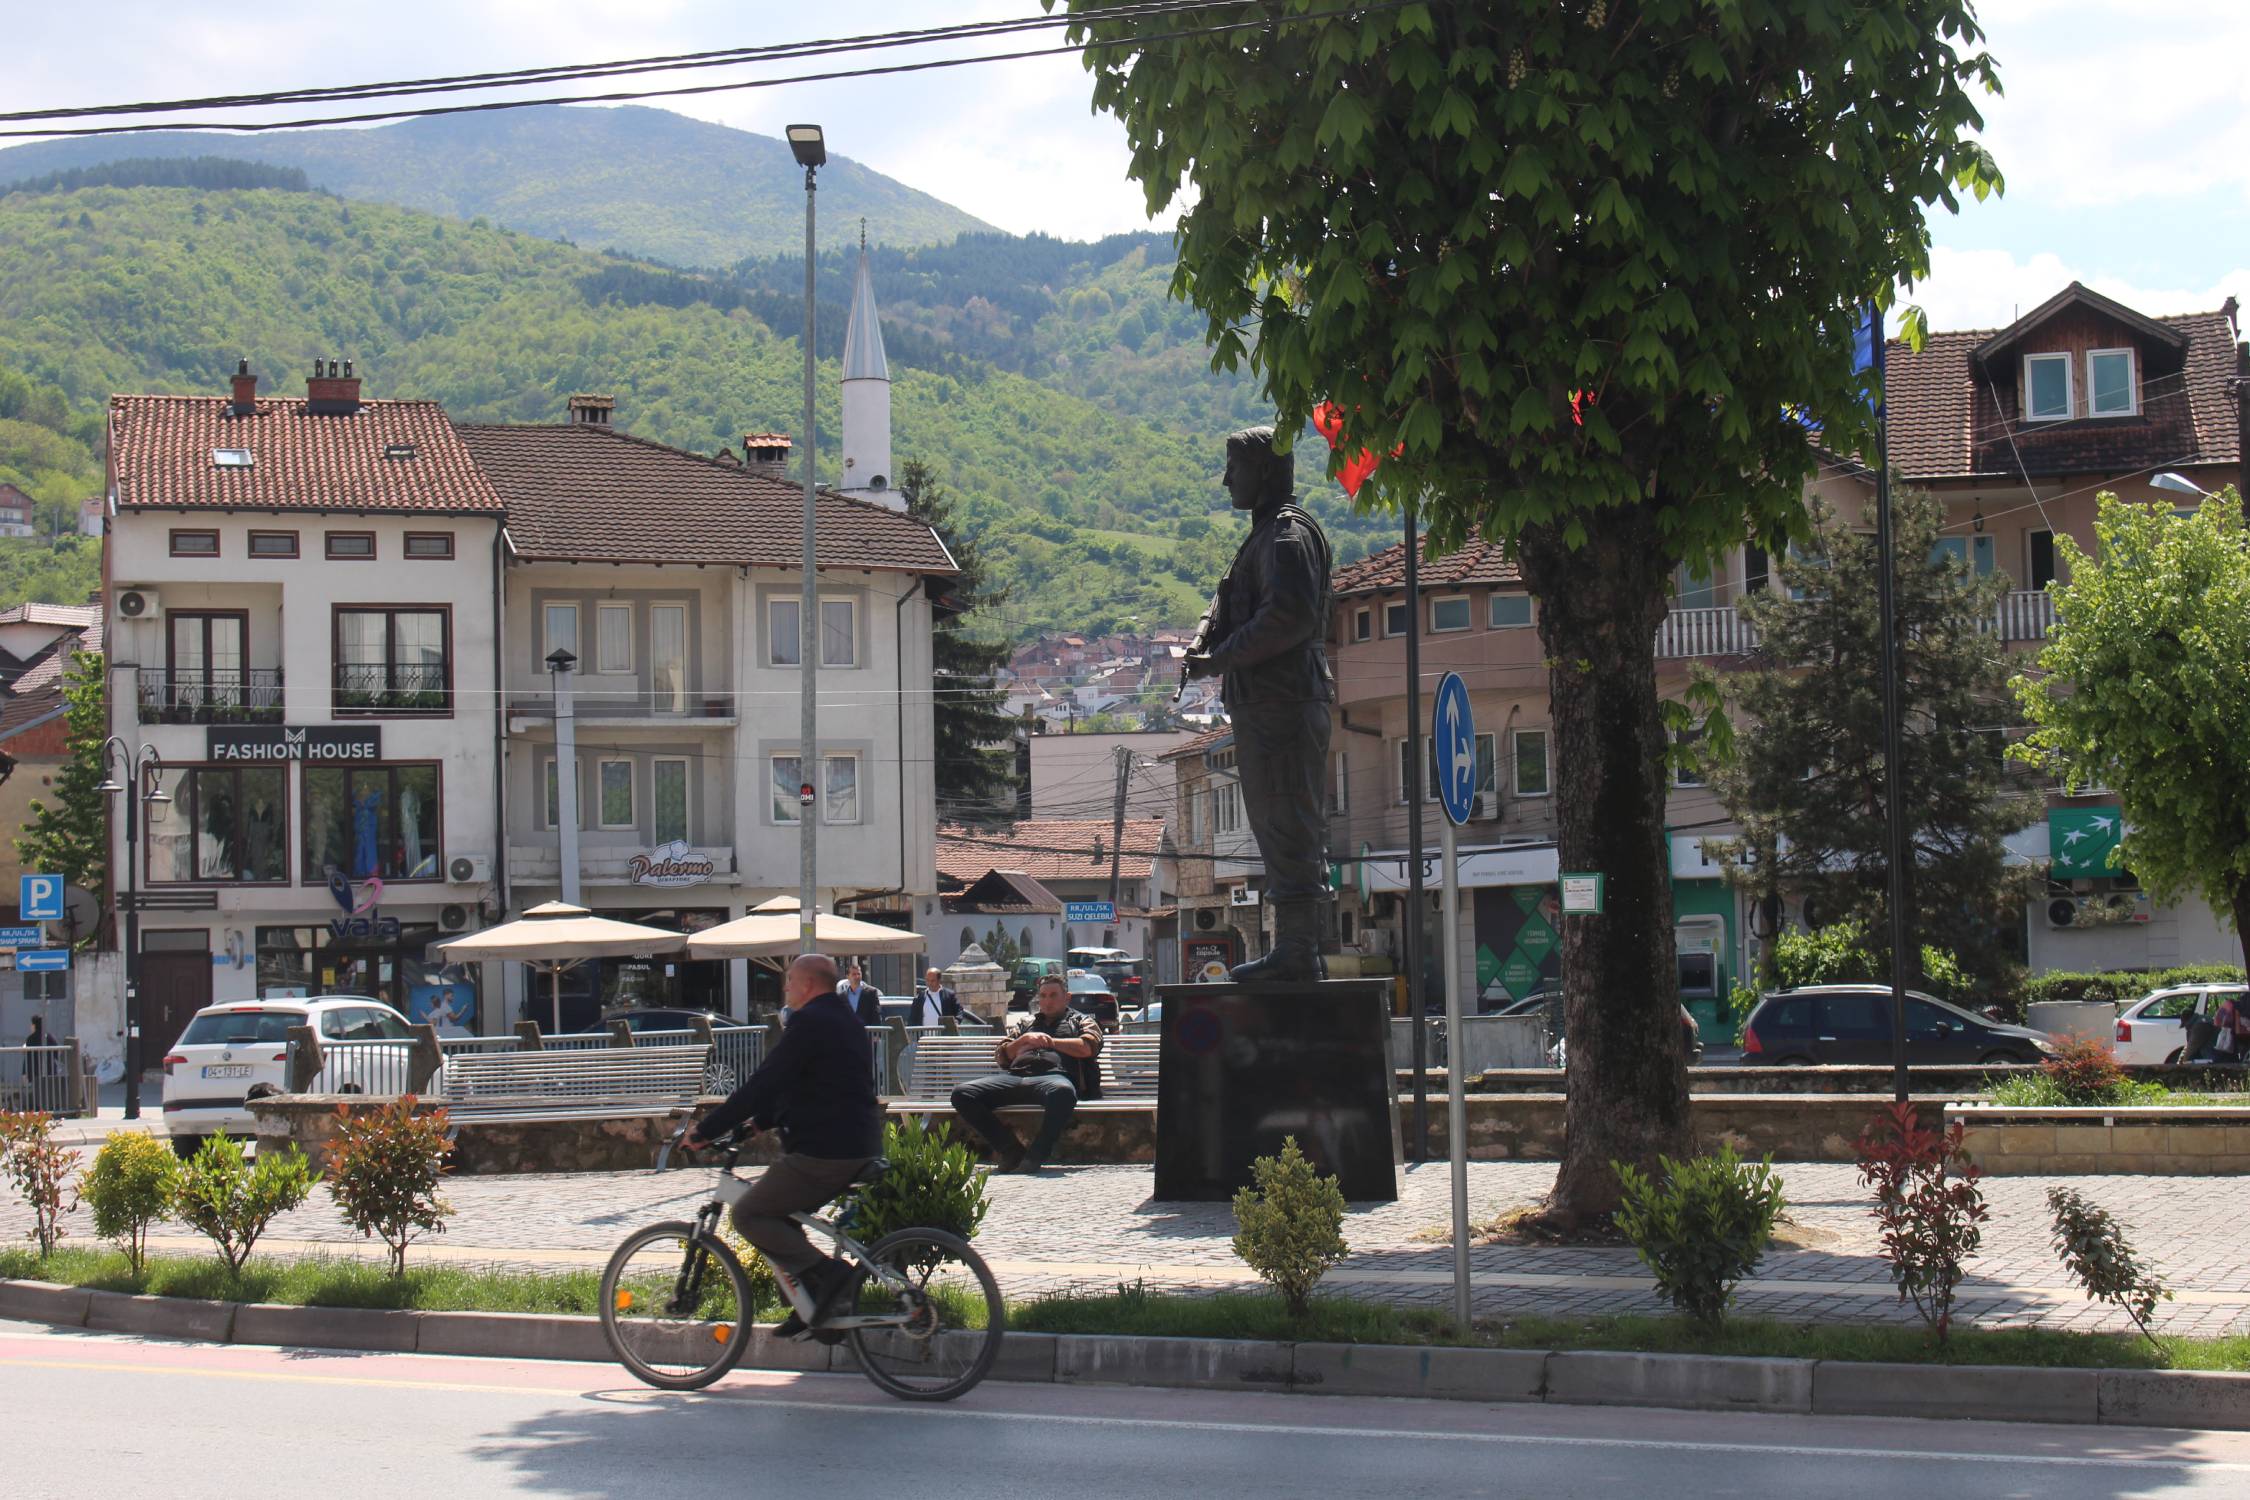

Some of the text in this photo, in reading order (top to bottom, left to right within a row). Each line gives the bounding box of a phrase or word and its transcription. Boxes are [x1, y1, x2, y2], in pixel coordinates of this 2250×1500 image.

[213, 743, 375, 760] FASHION HOUSE
[629, 855, 713, 883] Palermo
[1395, 857, 1433, 880] TB
[30, 879, 53, 908] P
[331, 905, 400, 938] vala
